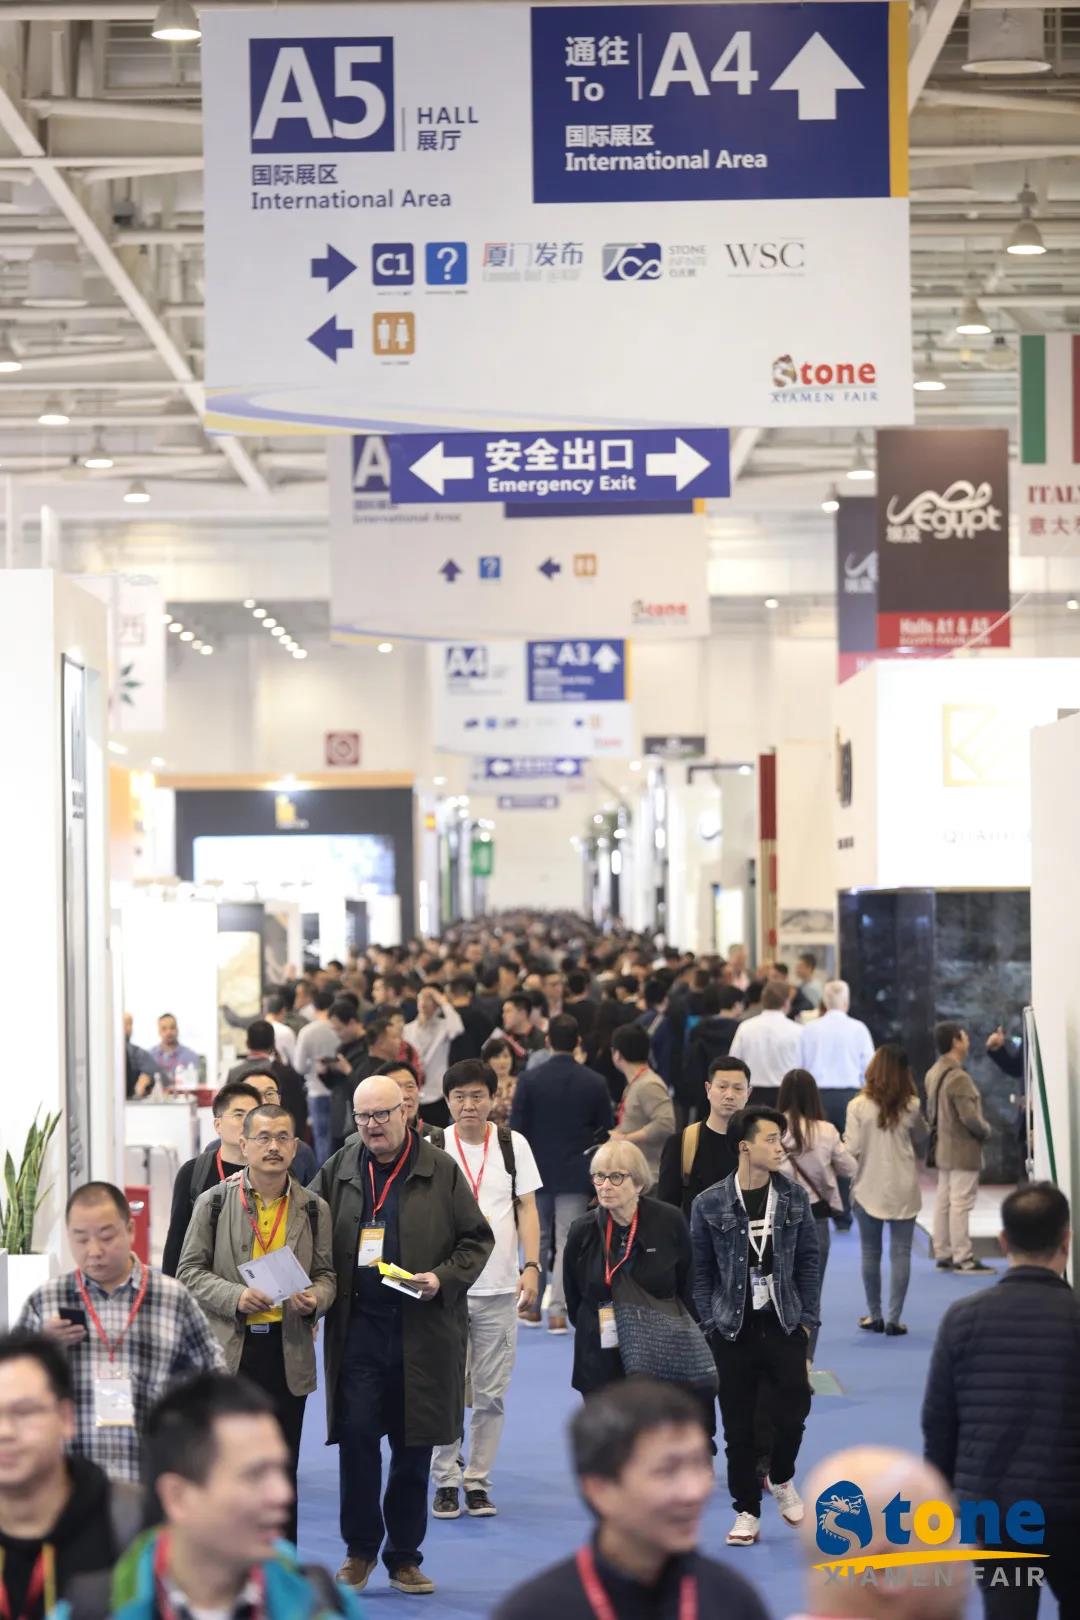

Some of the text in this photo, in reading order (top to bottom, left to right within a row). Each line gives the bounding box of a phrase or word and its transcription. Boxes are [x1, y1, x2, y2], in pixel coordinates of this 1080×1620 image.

[565, 36, 630, 67] 通往
[649, 31, 759, 97] A4
[252, 45, 387, 140] A5
[565, 76, 605, 102] To
[416, 106, 479, 124] HALL
[416, 130, 462, 151] 展厅
[565, 124, 655, 148] 国际展区
[565, 149, 768, 172] International Area
[251, 164, 339, 186] 国际展区
[251, 190, 451, 210] International Area
[375, 252, 411, 276] C1
[724, 242, 806, 270] WSC
[770, 391, 880, 404] XIAMEN FAIR
[485, 437, 634, 473] 安全出口
[487, 474, 637, 497] Emergency Exit
[1027, 484, 1080, 503] ITAL
